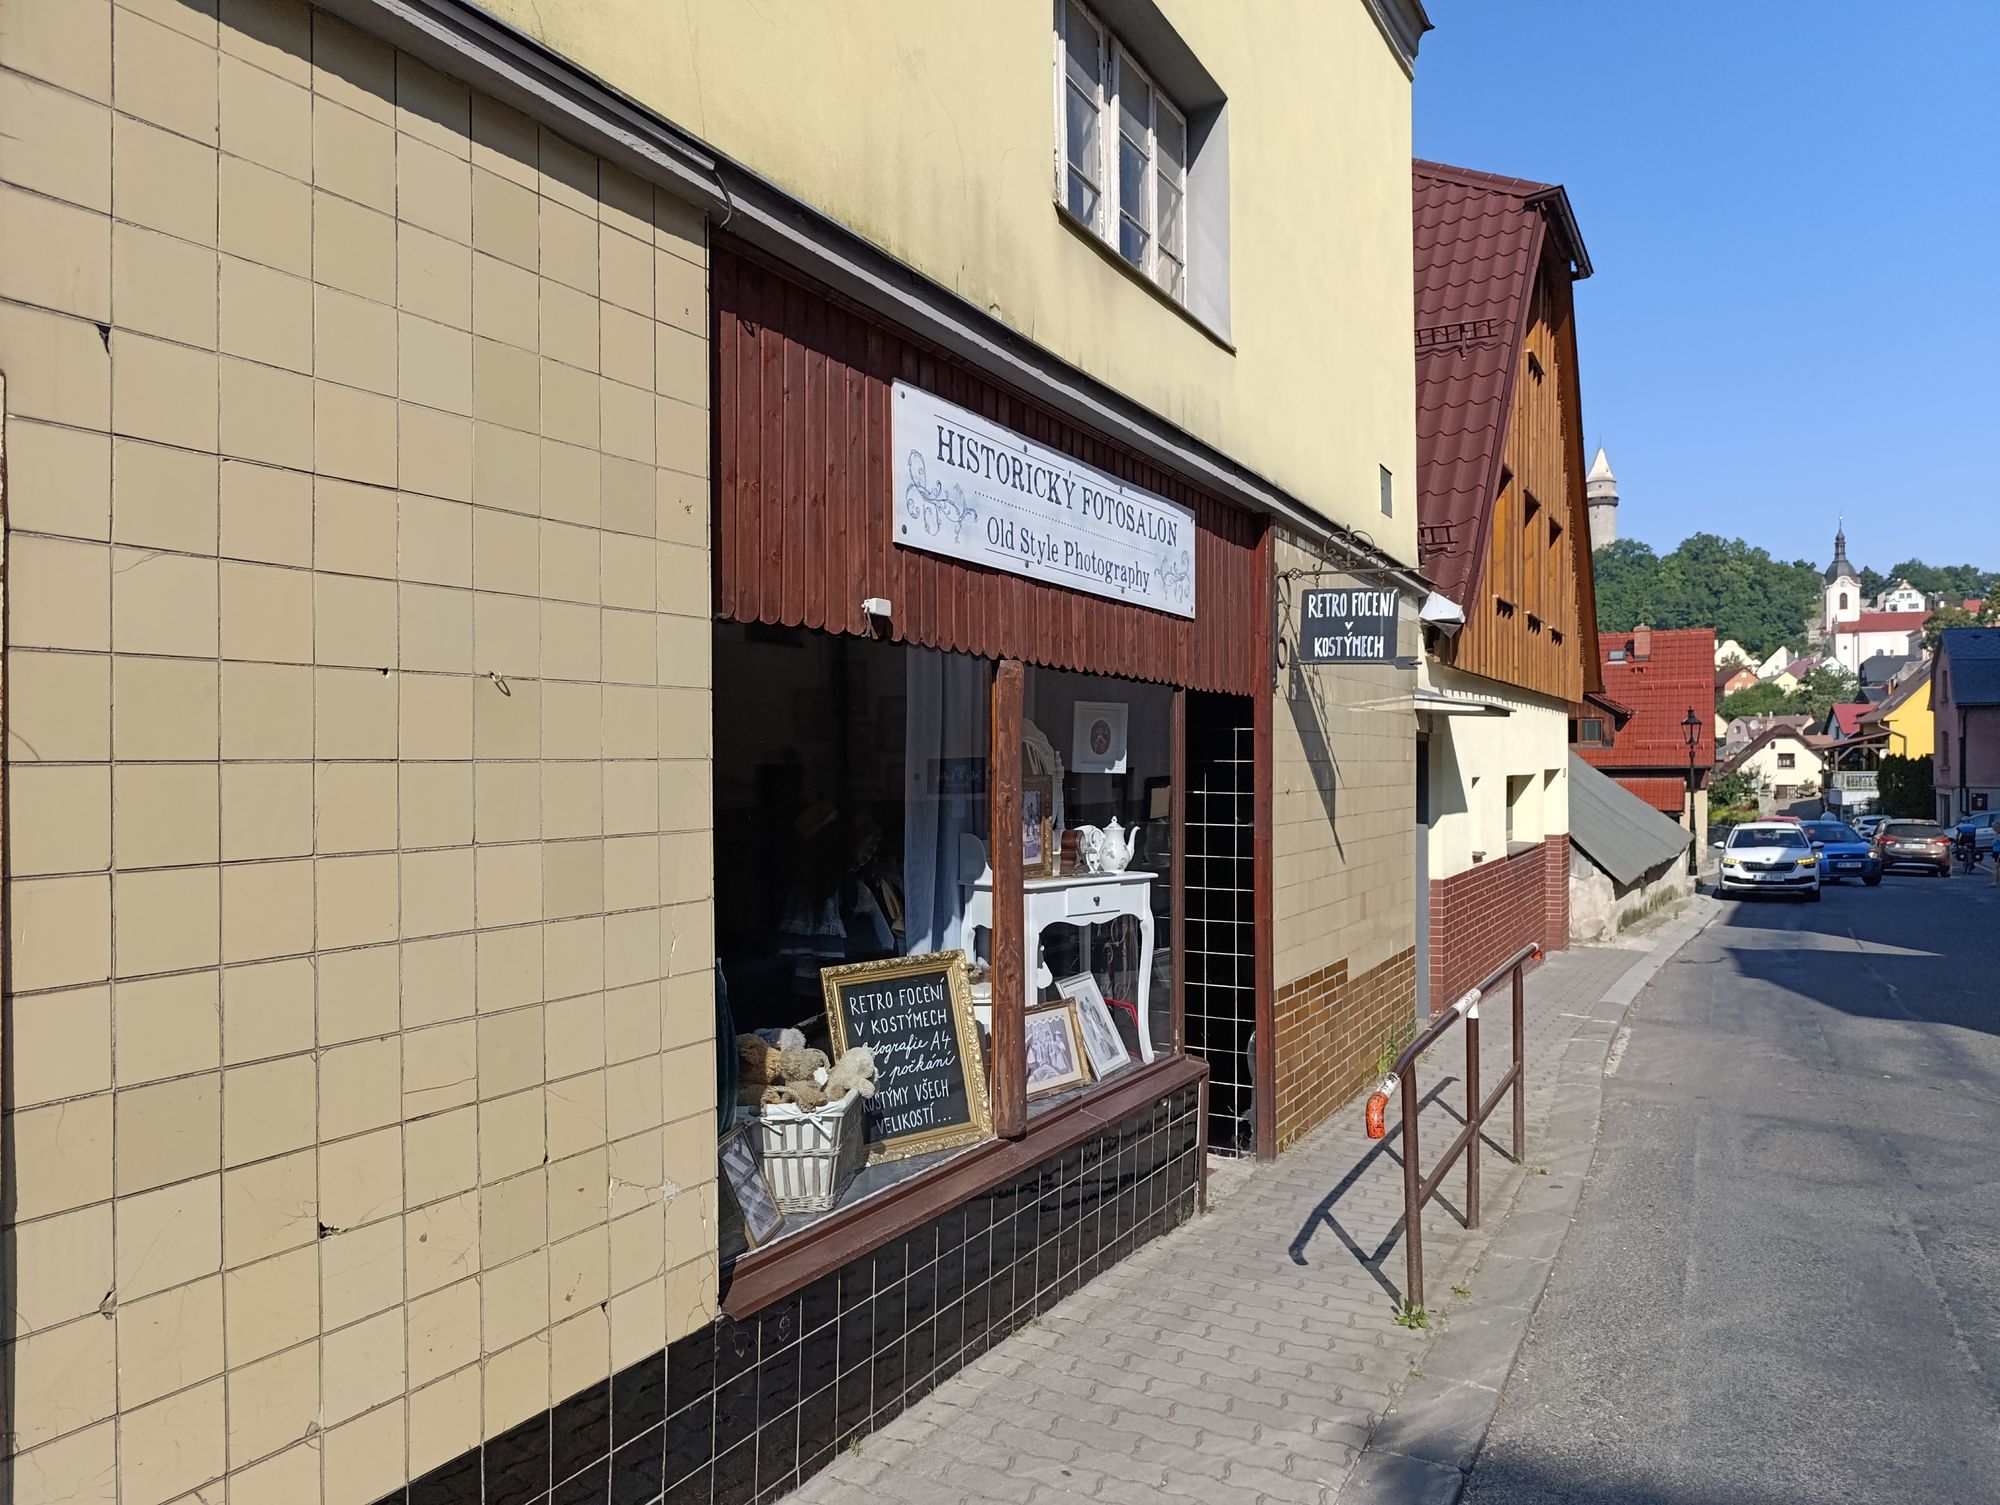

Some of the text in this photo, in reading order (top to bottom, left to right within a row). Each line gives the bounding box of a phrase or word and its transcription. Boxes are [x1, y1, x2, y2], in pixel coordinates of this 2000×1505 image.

[936, 424, 1178, 547] HISTORICKÝ FOTOSALON
[987, 516, 1150, 593] Old Style Photography
[1308, 589, 1398, 618] RETRO FOCENÍ
[1314, 632, 1385, 658] KOSTÝMECH
[849, 977, 946, 1016] RETRO FOCENÍ
[871, 1007, 947, 1035] KOSTÝMECH
[930, 1030, 952, 1051] A4
[889, 1051, 956, 1084] počkání
[915, 1078, 950, 1104] VŠECH
